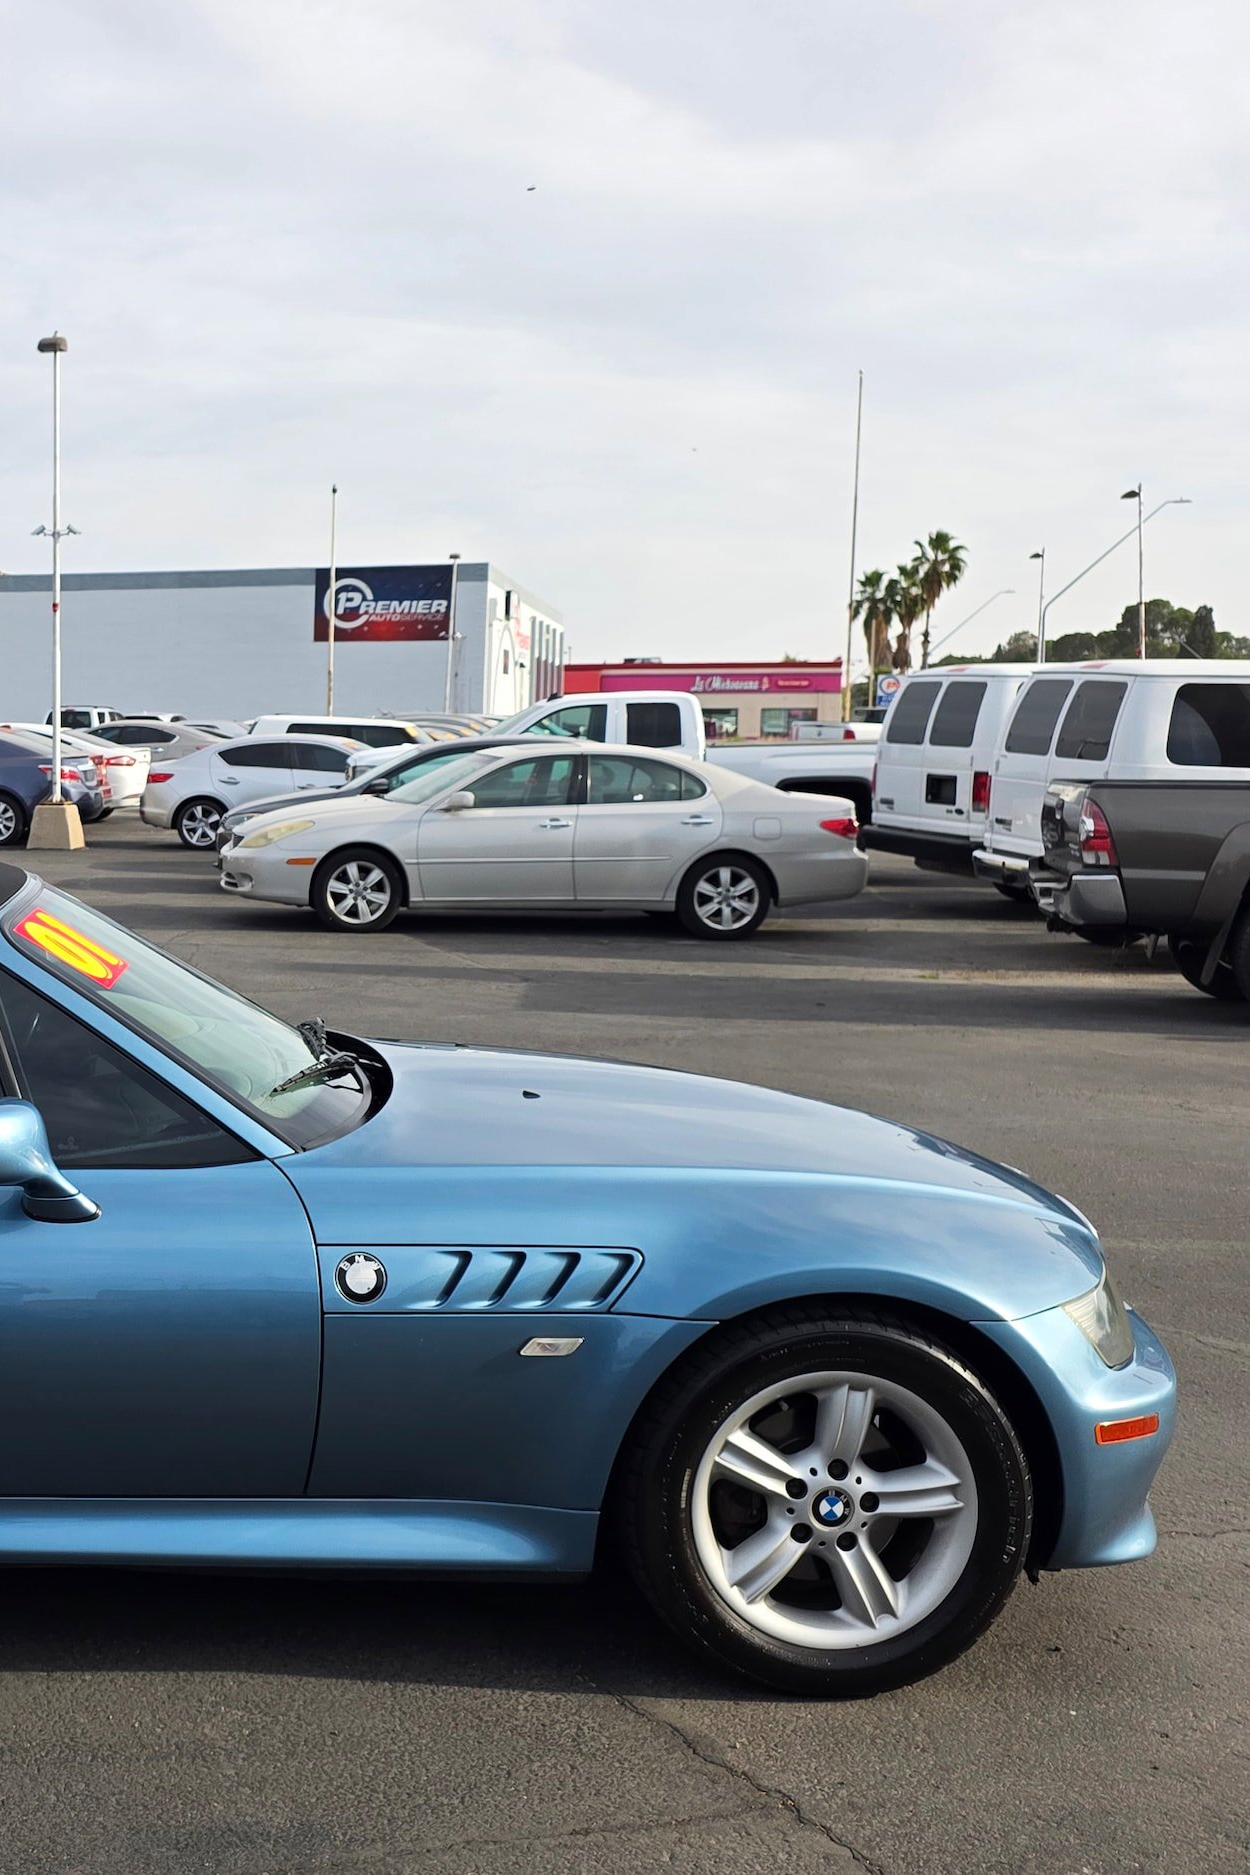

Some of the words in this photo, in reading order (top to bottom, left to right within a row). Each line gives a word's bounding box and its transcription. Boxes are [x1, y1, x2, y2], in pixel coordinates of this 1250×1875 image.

[336, 591, 449, 615] PREMIER
[340, 1254, 382, 1271] BMW
[828, 1489, 852, 1515] BMW
